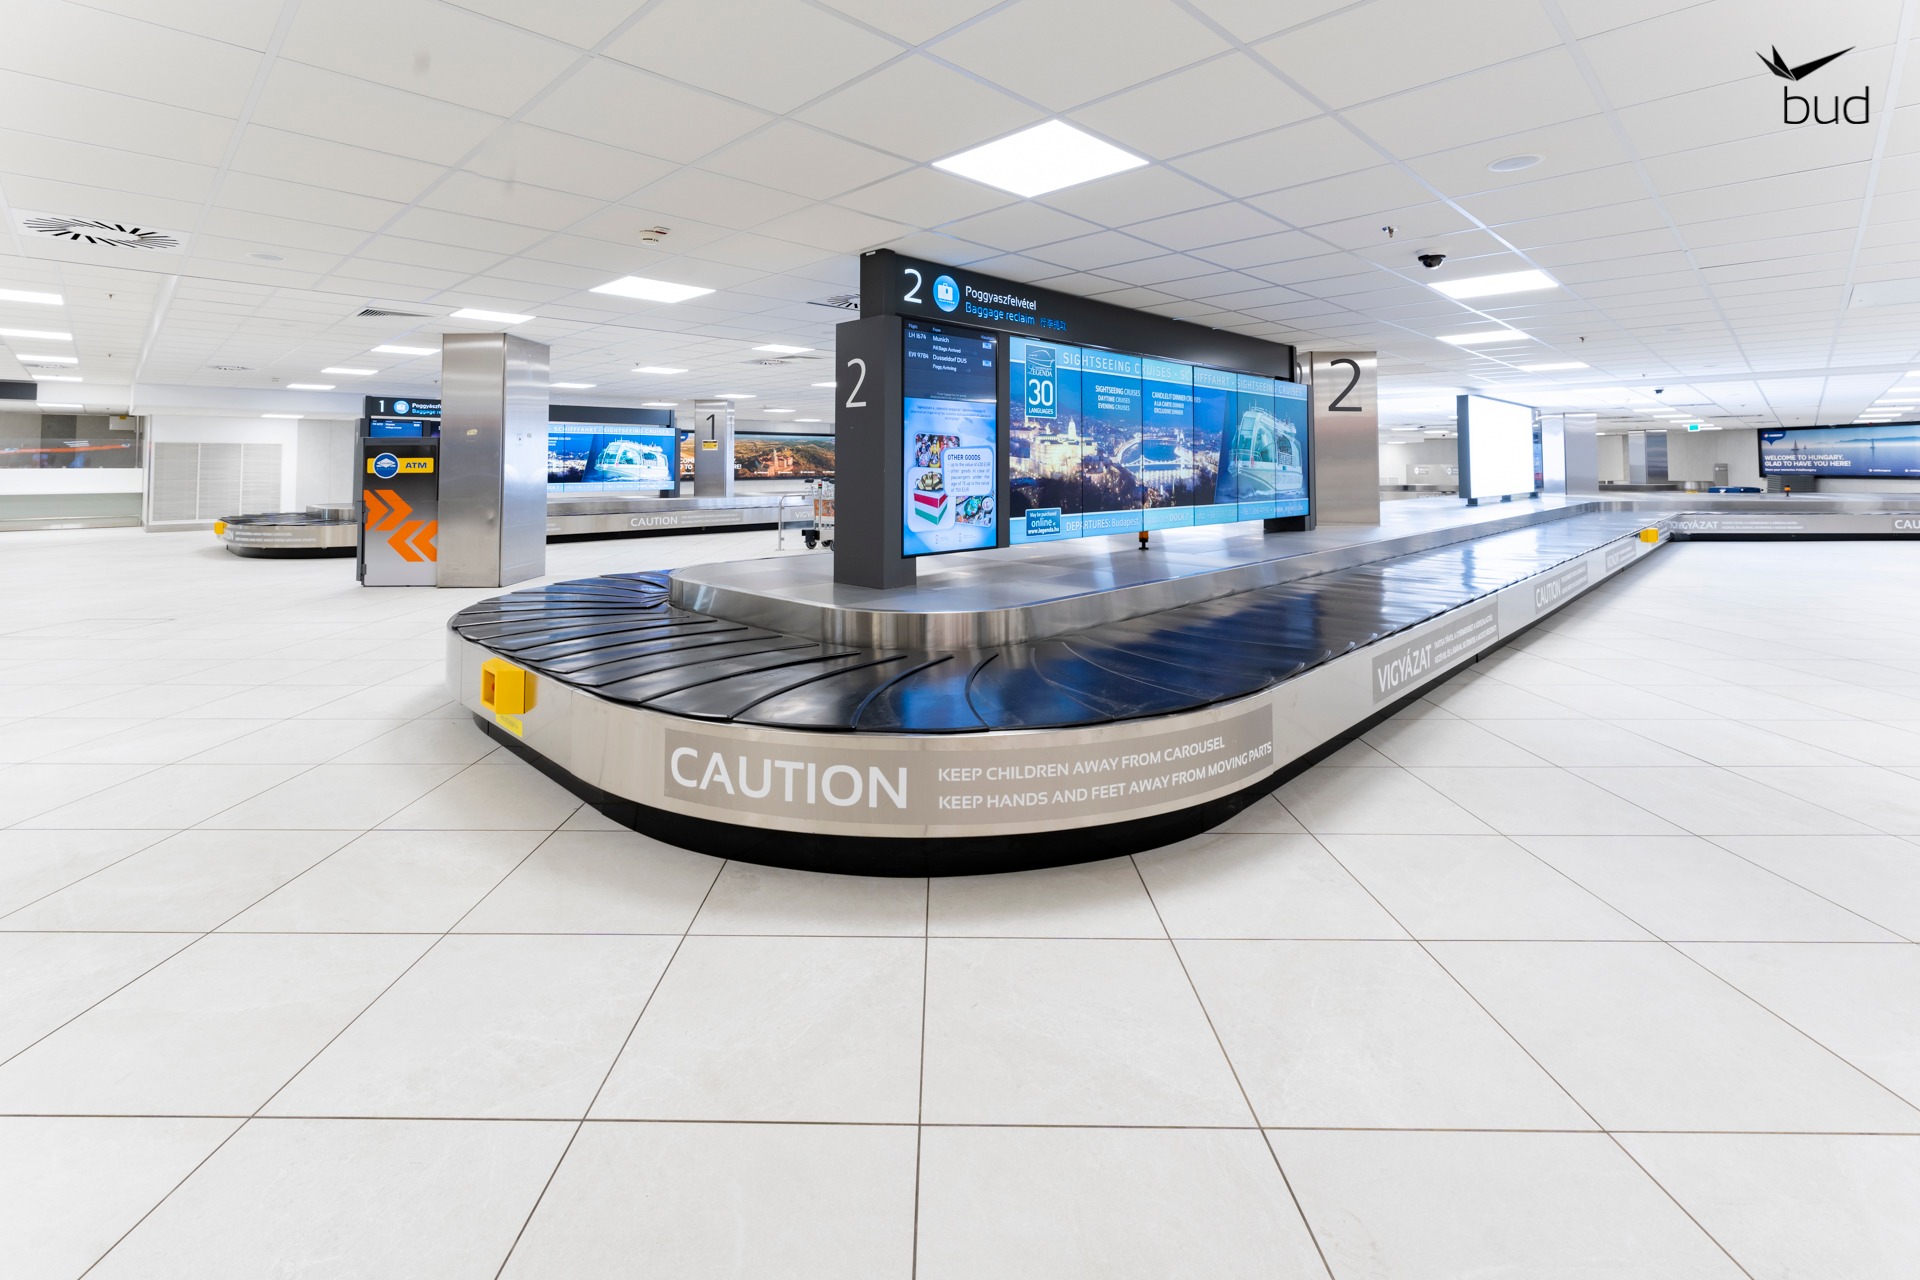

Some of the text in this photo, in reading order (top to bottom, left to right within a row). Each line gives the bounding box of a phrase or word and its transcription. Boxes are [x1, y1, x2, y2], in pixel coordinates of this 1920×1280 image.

[903, 268, 922, 304] 2
[965, 302, 1035, 325] Baggage reclaim
[932, 354, 956, 362] Dusseldorf
[1063, 352, 1131, 373] SIGHTSEEING
[1134, 362, 1172, 379] CRUISES
[846, 358, 866, 408] 2
[1029, 378, 1053, 406] 30
[1095, 385, 1140, 396] SIGHTSEEING CRUISES
[1328, 358, 1362, 412] 2
[379, 400, 384, 413] 1
[706, 414, 715, 440] 1
[630, 516, 678, 527] CAUTION
[1031, 518, 1052, 527] online
[1536, 578, 1561, 608] CAUTION
[1378, 644, 1432, 692] VIGYÁZAT
[670, 736, 1226, 808] CAUTION KEEP CHILDREN AWAY FROM CAROUSEL
[938, 741, 1272, 810] KEEP HANDS AND FEET AWAY FROM MOVING PARTS
